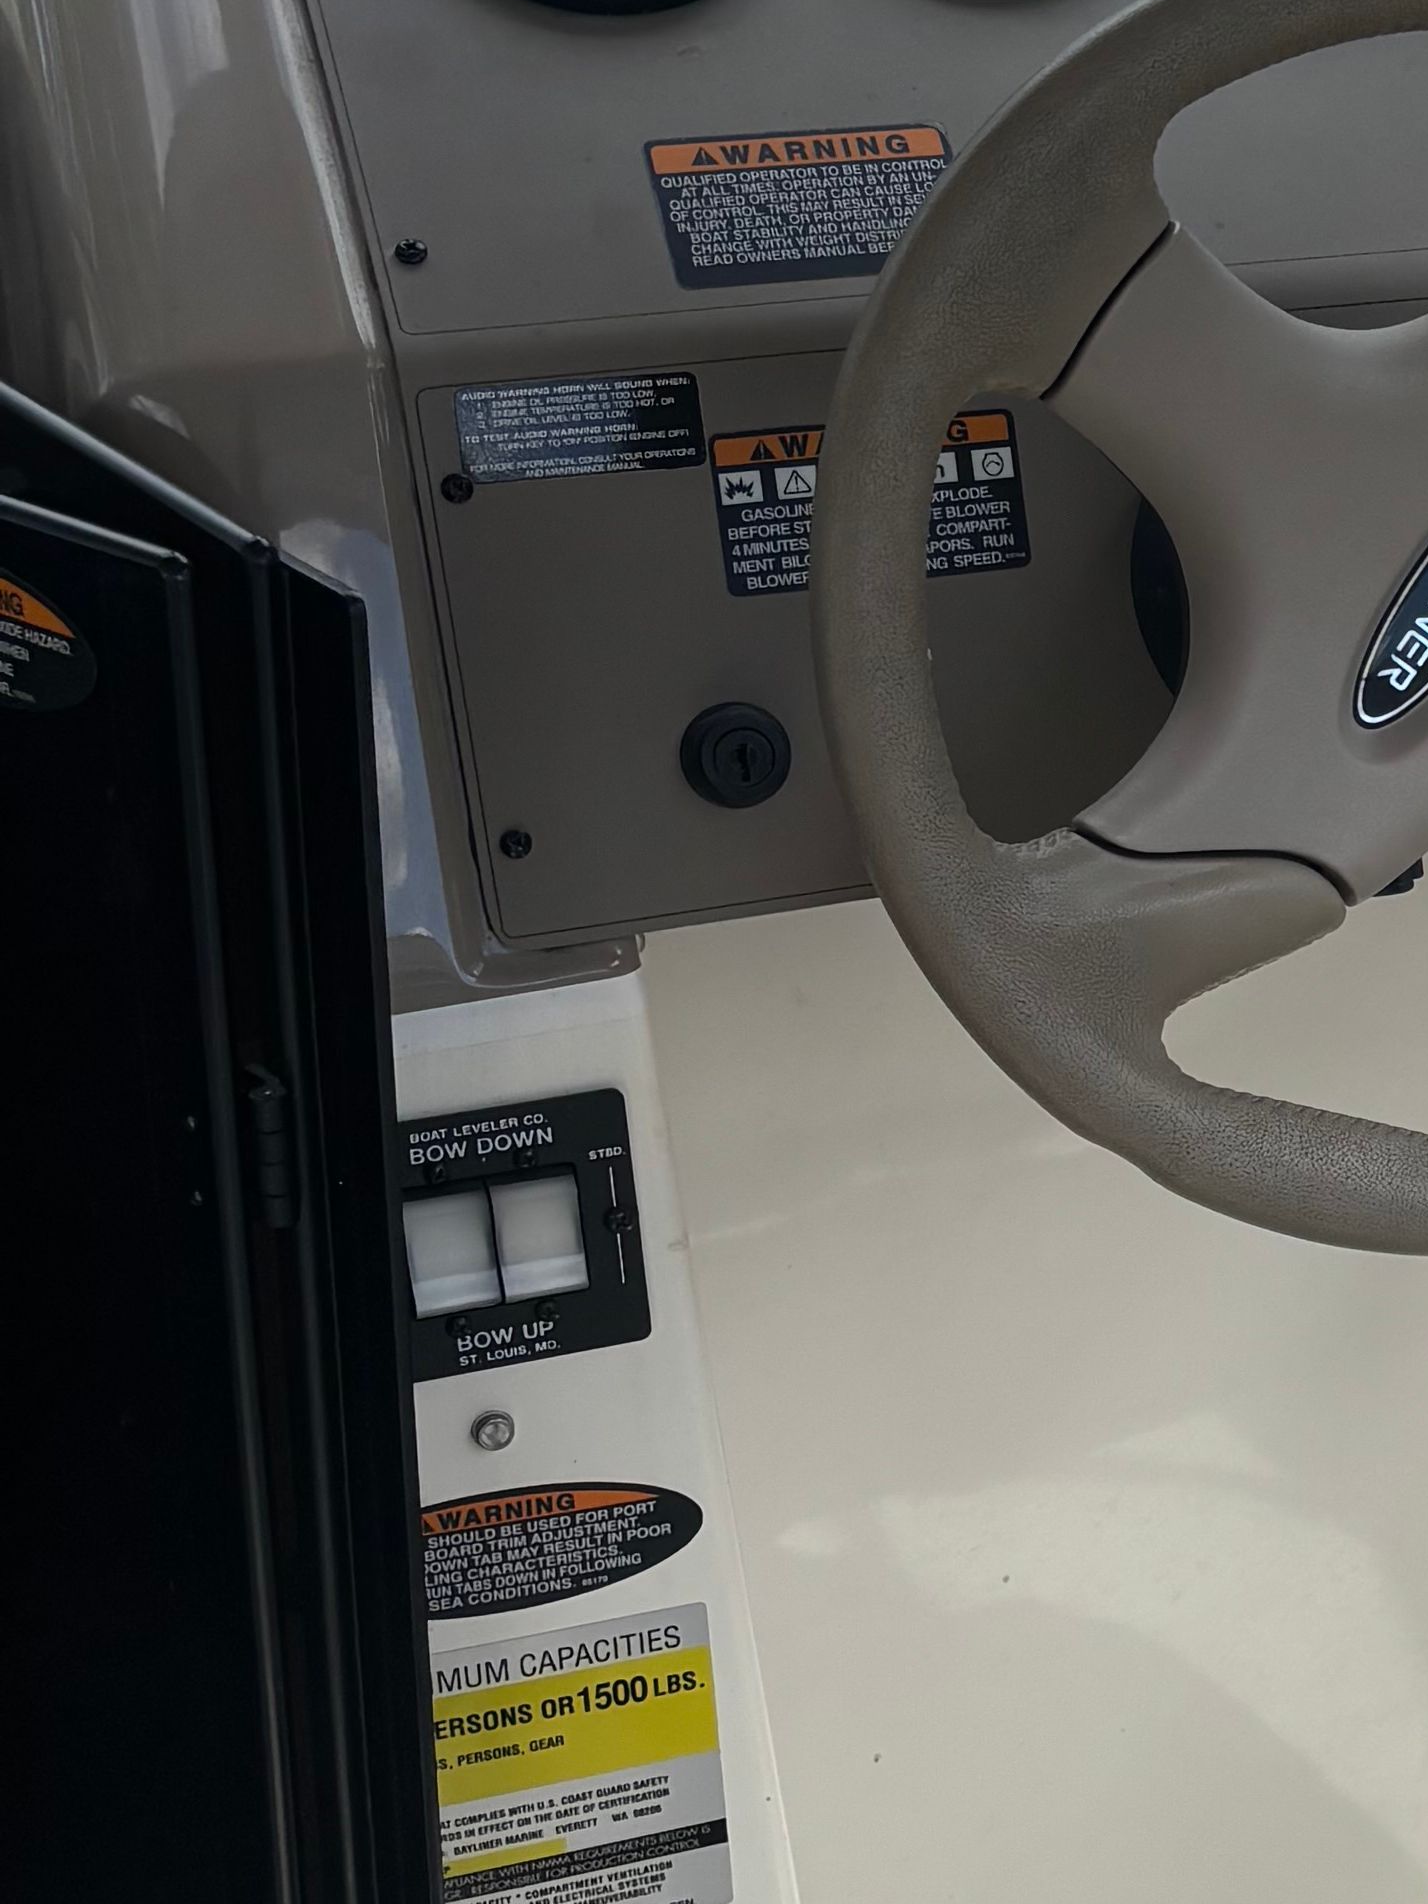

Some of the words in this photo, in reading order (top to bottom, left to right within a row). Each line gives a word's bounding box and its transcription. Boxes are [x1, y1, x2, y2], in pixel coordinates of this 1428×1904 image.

[720, 134, 910, 165] WARNING
[660, 172, 736, 188] QUALIFIED
[740, 166, 817, 182] OPERATOR
[820, 164, 838, 177] TO
[842, 163, 862, 175] BE
[864, 161, 878, 173] IN
[680, 187, 696, 198] AT
[702, 184, 730, 197] ALL
[781, 174, 863, 191] OPERATION
[867, 173, 884, 185] BY
[889, 171, 908, 183] AN
[690, 230, 728, 244] BOAT
[732, 225, 803, 240] STABILITY
[808, 222, 836, 235] AND
[692, 253, 732, 267] READ
[736, 248, 800, 264] OWNERS
[804, 243, 865, 259] MANUAL
[945, 500, 1010, 518] BLOWER
[727, 522, 790, 540] BEFORE
[732, 543, 740, 556] 4
[742, 537, 809, 556] MINUTES
[982, 533, 1014, 548] RUN
[733, 557, 775, 573] MENT
[409, 1128, 447, 1144] BOAT
[453, 1117, 518, 1137] LEVELER
[523, 1113, 548, 1125] CO.
[409, 1141, 467, 1165] BOW
[477, 1127, 553, 1155] DOWN
[456, 1325, 514, 1352] BOW
[522, 1320, 554, 1338] UP
[459, 1353, 482, 1367] ST.
[428, 1527, 495, 1549] SHOULD
[500, 1522, 522, 1537] BE
[526, 1515, 571, 1532] USED
[575, 1509, 608, 1524] FOR
[613, 1501, 656, 1518] PORT
[437, 1492, 574, 1530] WARNING
[471, 1551, 502, 1567] TAB
[507, 1545, 539, 1560] MAY
[542, 1534, 602, 1554] RESULT
[608, 1531, 622, 1544] IN
[626, 1522, 671, 1541] POOR
[486, 1535, 526, 1551] TRIM
[531, 1516, 640, 1544] ADJUSTMENT.
[455, 1578, 491, 1594] TABS
[495, 1570, 538, 1588] DOWN
[542, 1568, 555, 1579] IN
[560, 1552, 641, 1577] FOLLOWING
[467, 1544, 622, 1580] CHARACTERISTICS.
[428, 1595, 462, 1612] SEA
[468, 1577, 576, 1605] CONDITIONS.
[520, 1624, 680, 1678] CAPACITIES
[436, 1702, 532, 1739] ERSONS
[541, 1694, 574, 1719] OR
[577, 1674, 647, 1714] 1500
[653, 1668, 705, 1697] LBS.
[529, 1734, 564, 1751] GEAR
